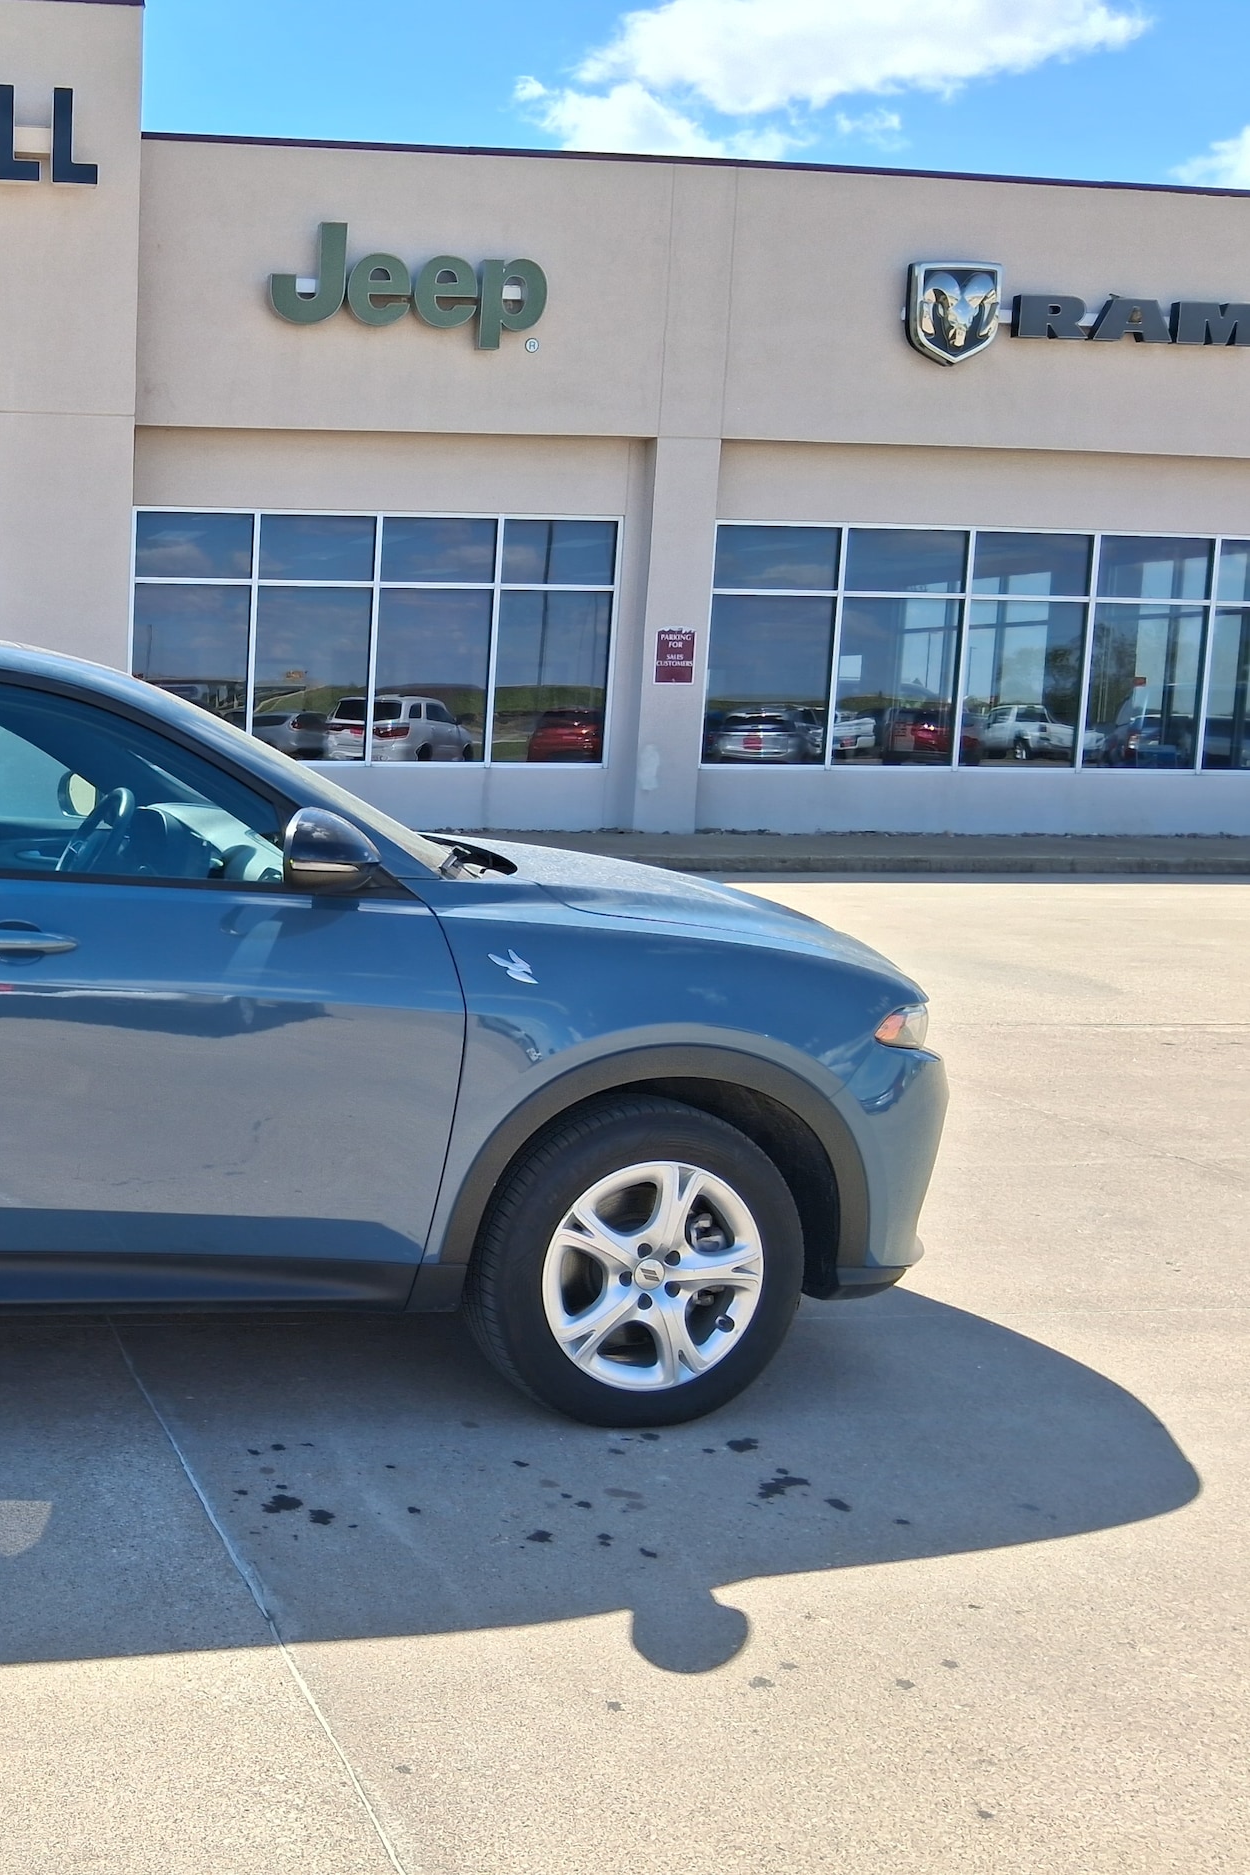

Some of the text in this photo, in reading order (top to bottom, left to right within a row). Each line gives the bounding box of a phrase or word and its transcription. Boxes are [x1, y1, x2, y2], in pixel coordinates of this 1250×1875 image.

[269, 221, 548, 350] Jeep
[1010, 294, 1250, 347] RAM
[660, 633, 692, 641] PARKING
[668, 641, 683, 649] FOR
[666, 653, 684, 661] SALES
